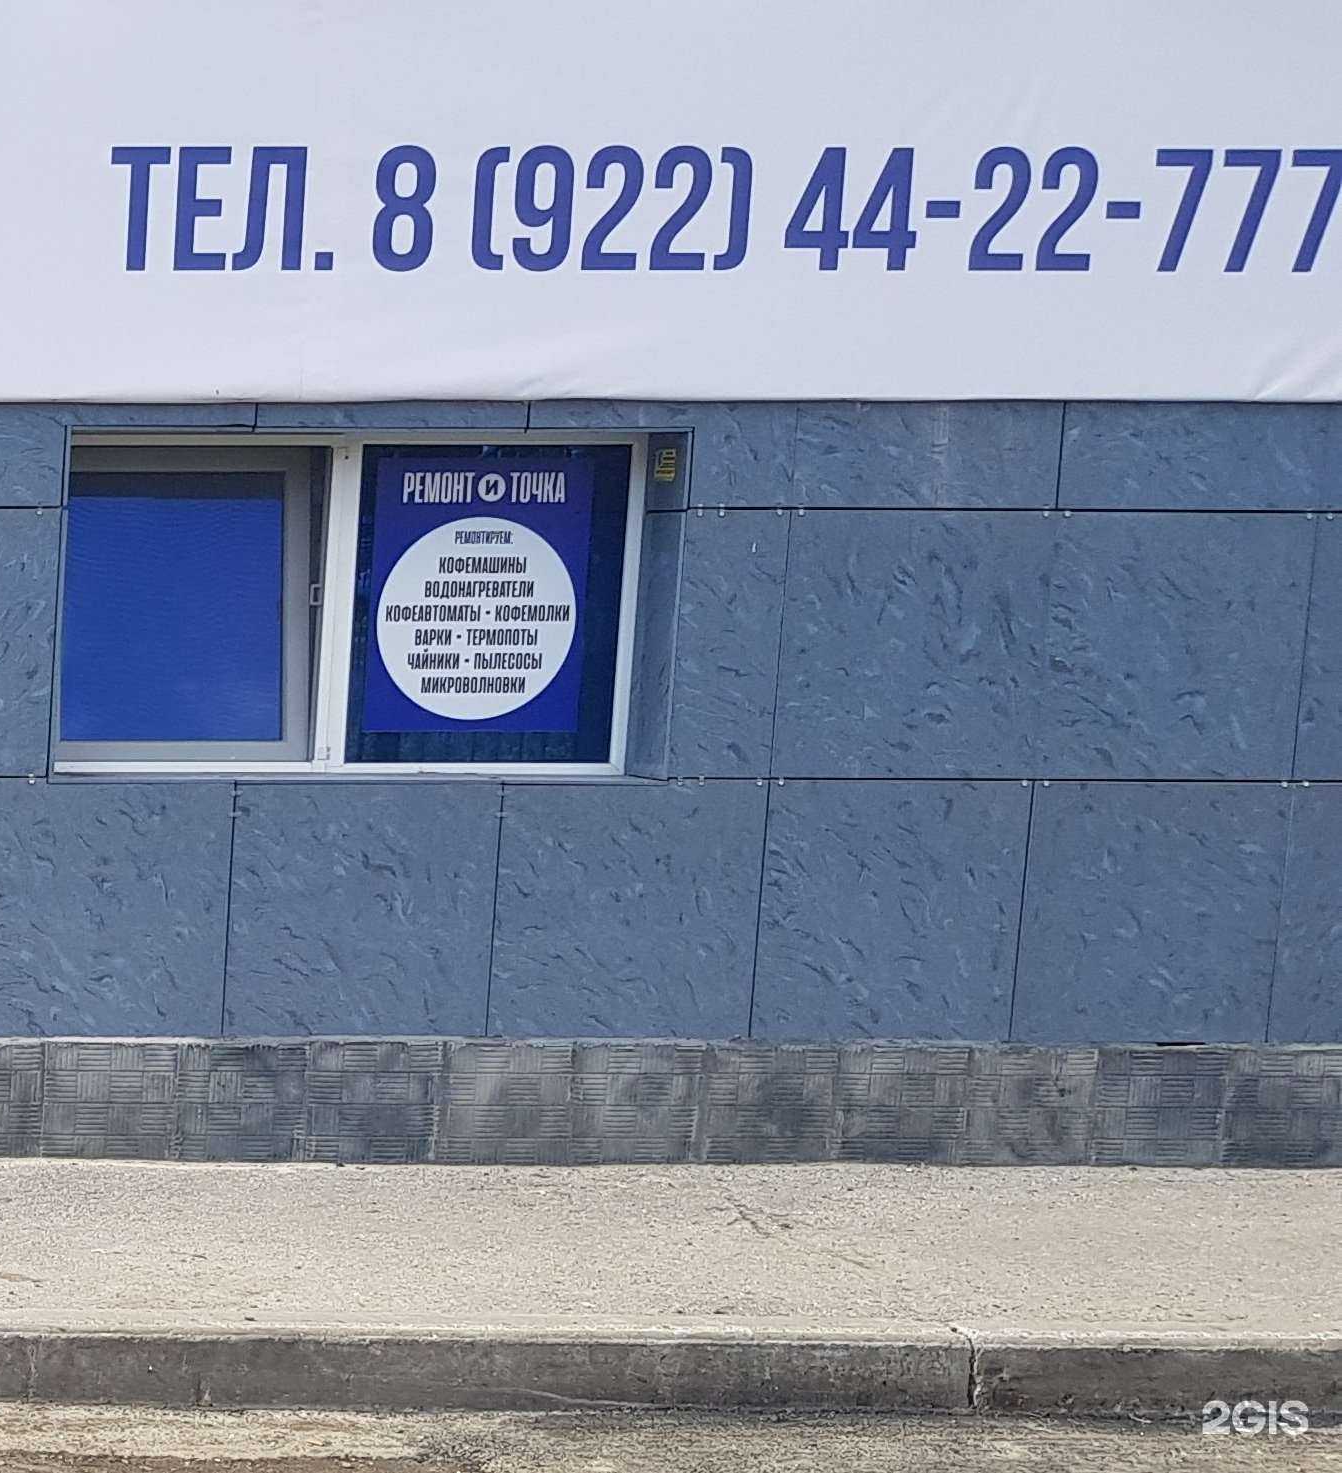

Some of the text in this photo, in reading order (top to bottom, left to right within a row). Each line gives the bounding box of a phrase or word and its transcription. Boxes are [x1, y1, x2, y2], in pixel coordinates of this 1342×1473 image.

[111, 144, 1342, 272] ТЕЛ. 8 (922) 44-22-777
[402, 472, 475, 503] РЕМОНТ
[510, 472, 566, 503] ТОЧКА
[439, 557, 527, 574] КОФЕМАШИНЫ
[424, 581, 534, 599] ВОДОНАГРЕВАТЕЛИ
[385, 605, 570, 622] КОФЕАВТОМАТЫ КОФЕМОЛКИ
[415, 629, 538, 646] ВАРКИ ТЕРМОПОТЫ
[407, 649, 542, 670] ЧАЙНИКИ ПЫЛЕСОСЫ
[420, 676, 526, 694] МИКРОВОЛНОВКИ
